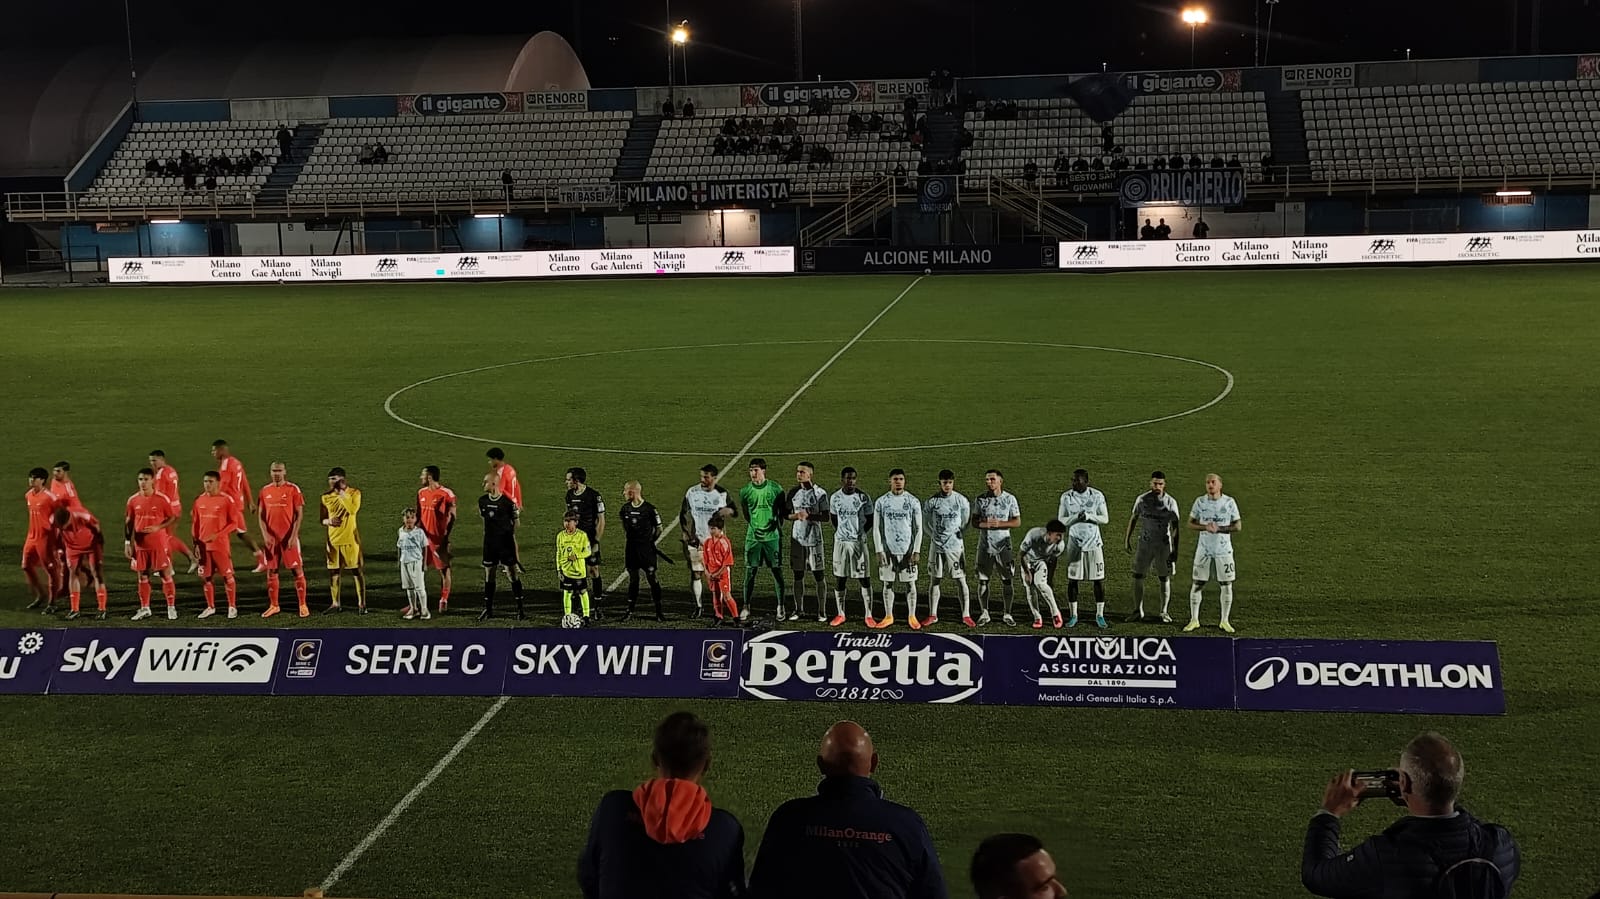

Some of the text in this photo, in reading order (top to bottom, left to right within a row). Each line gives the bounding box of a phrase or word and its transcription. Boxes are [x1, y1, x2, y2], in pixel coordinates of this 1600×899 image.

[1296, 67, 1352, 80] RENORD
[889, 82, 929, 94] RENOR
[1143, 73, 1216, 92] gigante
[538, 92, 585, 104] RENORD
[768, 85, 852, 103] il gigante
[422, 96, 500, 113] il gigante
[627, 182, 788, 203] MILANO INTERISTA
[1073, 182, 1113, 192] GIOVANNI
[1150, 171, 1242, 204] BRUGHERIO
[1175, 243, 1210, 252] Milano
[1233, 241, 1269, 251] Milano
[1292, 240, 1328, 250] Milano
[548, 253, 580, 262] Milano
[600, 252, 632, 261] Milano
[653, 251, 686, 260] Milano
[864, 248, 992, 265] ALCIONE MILANO
[1176, 252, 1210, 262] Centro
[1222, 251, 1280, 262] Gae Aulenti
[1292, 250, 1328, 262] Navigli
[210, 260, 240, 269] Milano
[260, 259, 291, 268] Milano
[310, 258, 342, 268] Milano
[549, 262, 580, 272] Centro
[591, 261, 643, 270] Gae Aulenti
[654, 260, 686, 272] Navigli
[211, 269, 241, 278] Centro
[251, 268, 302, 278] Gae Aulenti
[312, 268, 342, 279] Navigli
[833, 632, 893, 648] Fratelli
[1038, 636, 1177, 661] CATTOLICA
[60, 640, 220, 680] sky wifi
[345, 644, 486, 675] SERIE C
[512, 643, 674, 676] SKY WIFI
[744, 641, 974, 687] Beretta
[1038, 663, 1177, 675] ASSICURAZIONI
[1295, 662, 1493, 689] DECATHLON
[838, 687, 880, 700] 1812
[1038, 693, 1177, 706] Marchio di Generali Italia S.p.A.
[806, 825, 893, 843] MilanOrange
